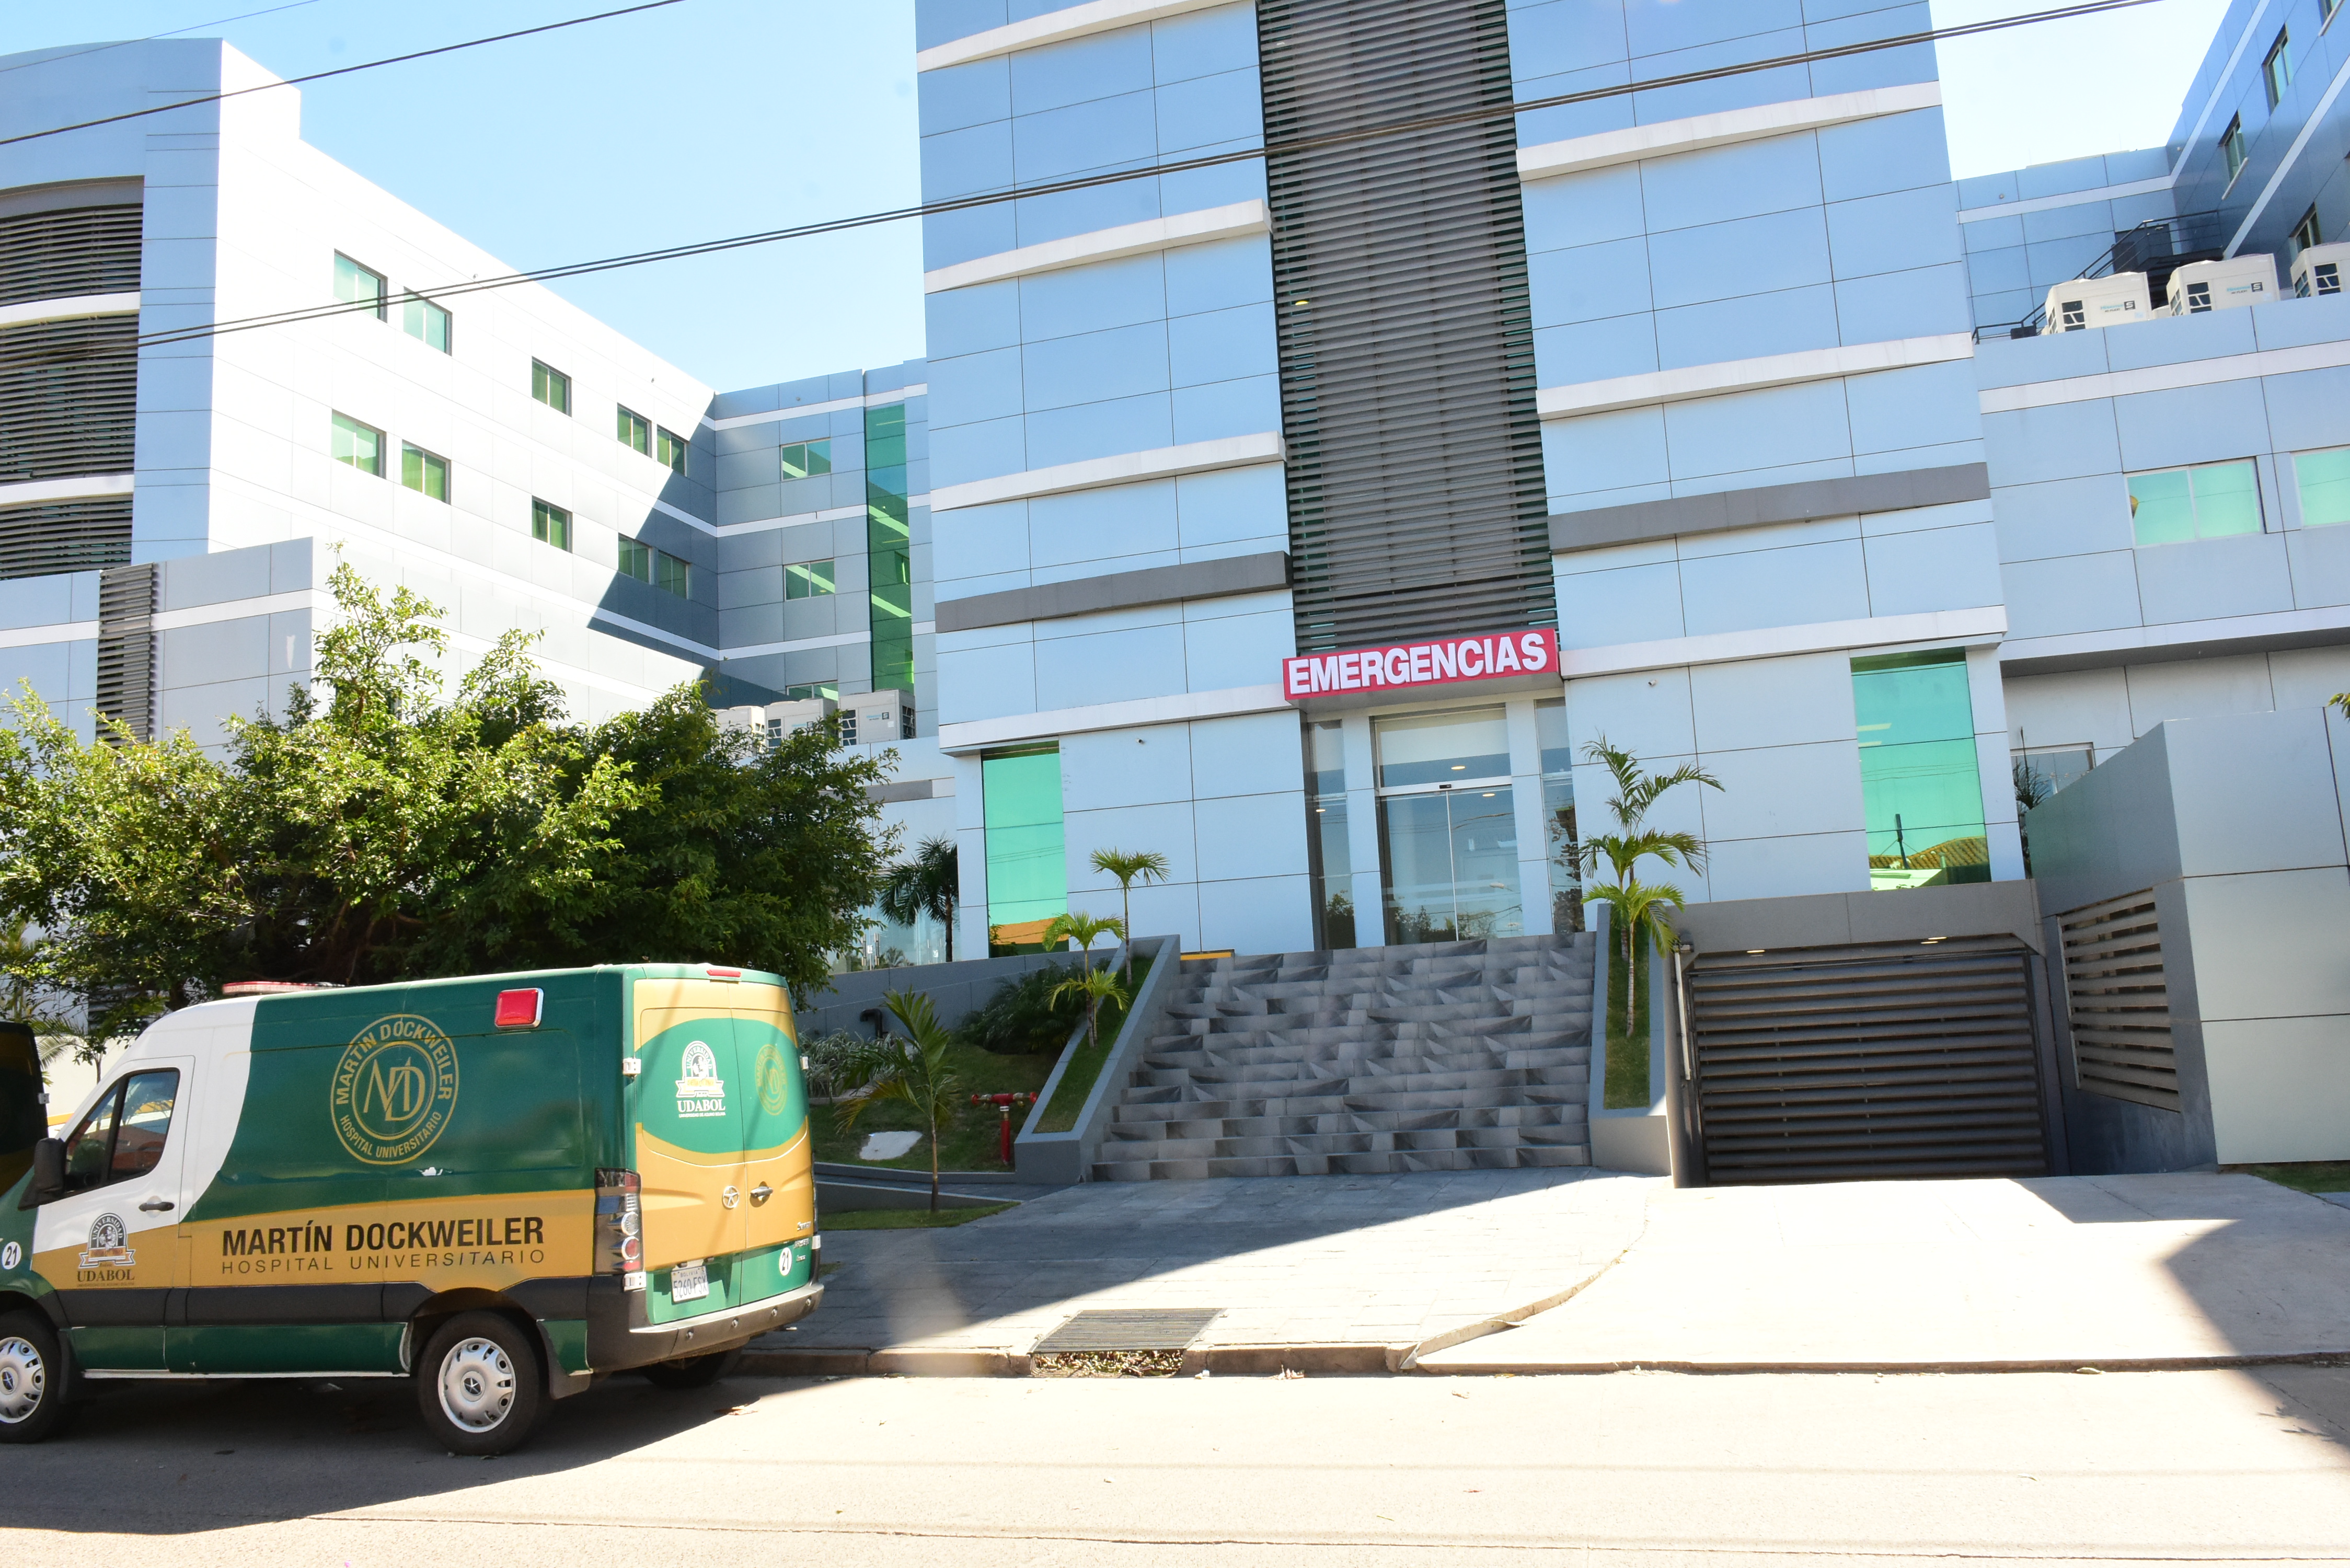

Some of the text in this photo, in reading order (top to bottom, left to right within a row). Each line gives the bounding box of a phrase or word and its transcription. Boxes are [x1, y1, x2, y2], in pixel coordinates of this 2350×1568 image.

[1288, 633, 1548, 695] EMERGENCIAS
[336, 1021, 453, 1105] MARTIN DOCKWEILER
[686, 1046, 712, 1069] UNIVERSIDAD
[677, 1099, 725, 1112] UDABOL
[340, 1112, 442, 1158] HOSPITAL UNIVERSITARIO
[93, 1217, 123, 1240] UNIVERSIDAD
[222, 1217, 544, 1256] MARTÍN DOCKWEILER
[5, 1245, 17, 1266] 21
[222, 1250, 544, 1274] HOSPITAL UNIVERSITARIO
[782, 1250, 789, 1271] 21
[77, 1269, 135, 1282] UDABOL
[674, 1278, 692, 1297] 5260
